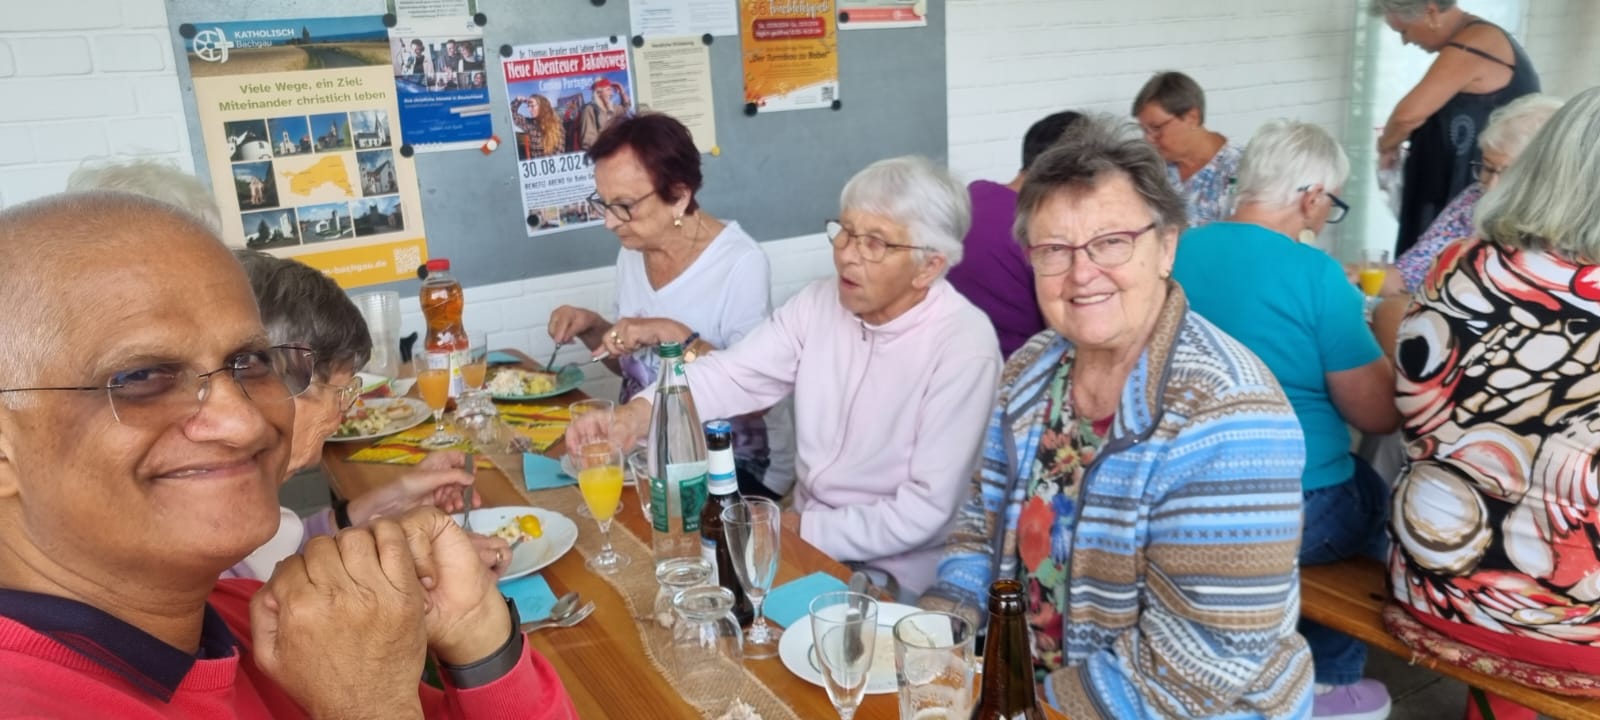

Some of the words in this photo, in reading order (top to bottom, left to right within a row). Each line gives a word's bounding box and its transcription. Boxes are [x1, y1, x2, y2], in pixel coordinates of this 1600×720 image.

[234, 28, 295, 39] KATHOLISCH
[236, 40, 272, 49] Bachgau
[507, 61, 531, 79] Neue
[533, 58, 579, 76] Abenteuer
[582, 53, 626, 71] Jakobsweg
[240, 83, 271, 94] Viele
[275, 80, 312, 92] Wege,
[316, 79, 334, 89] ein
[337, 77, 363, 87] Ziel:
[219, 98, 292, 112] Miteinander
[296, 94, 351, 106] christlich
[354, 91, 386, 101] leben
